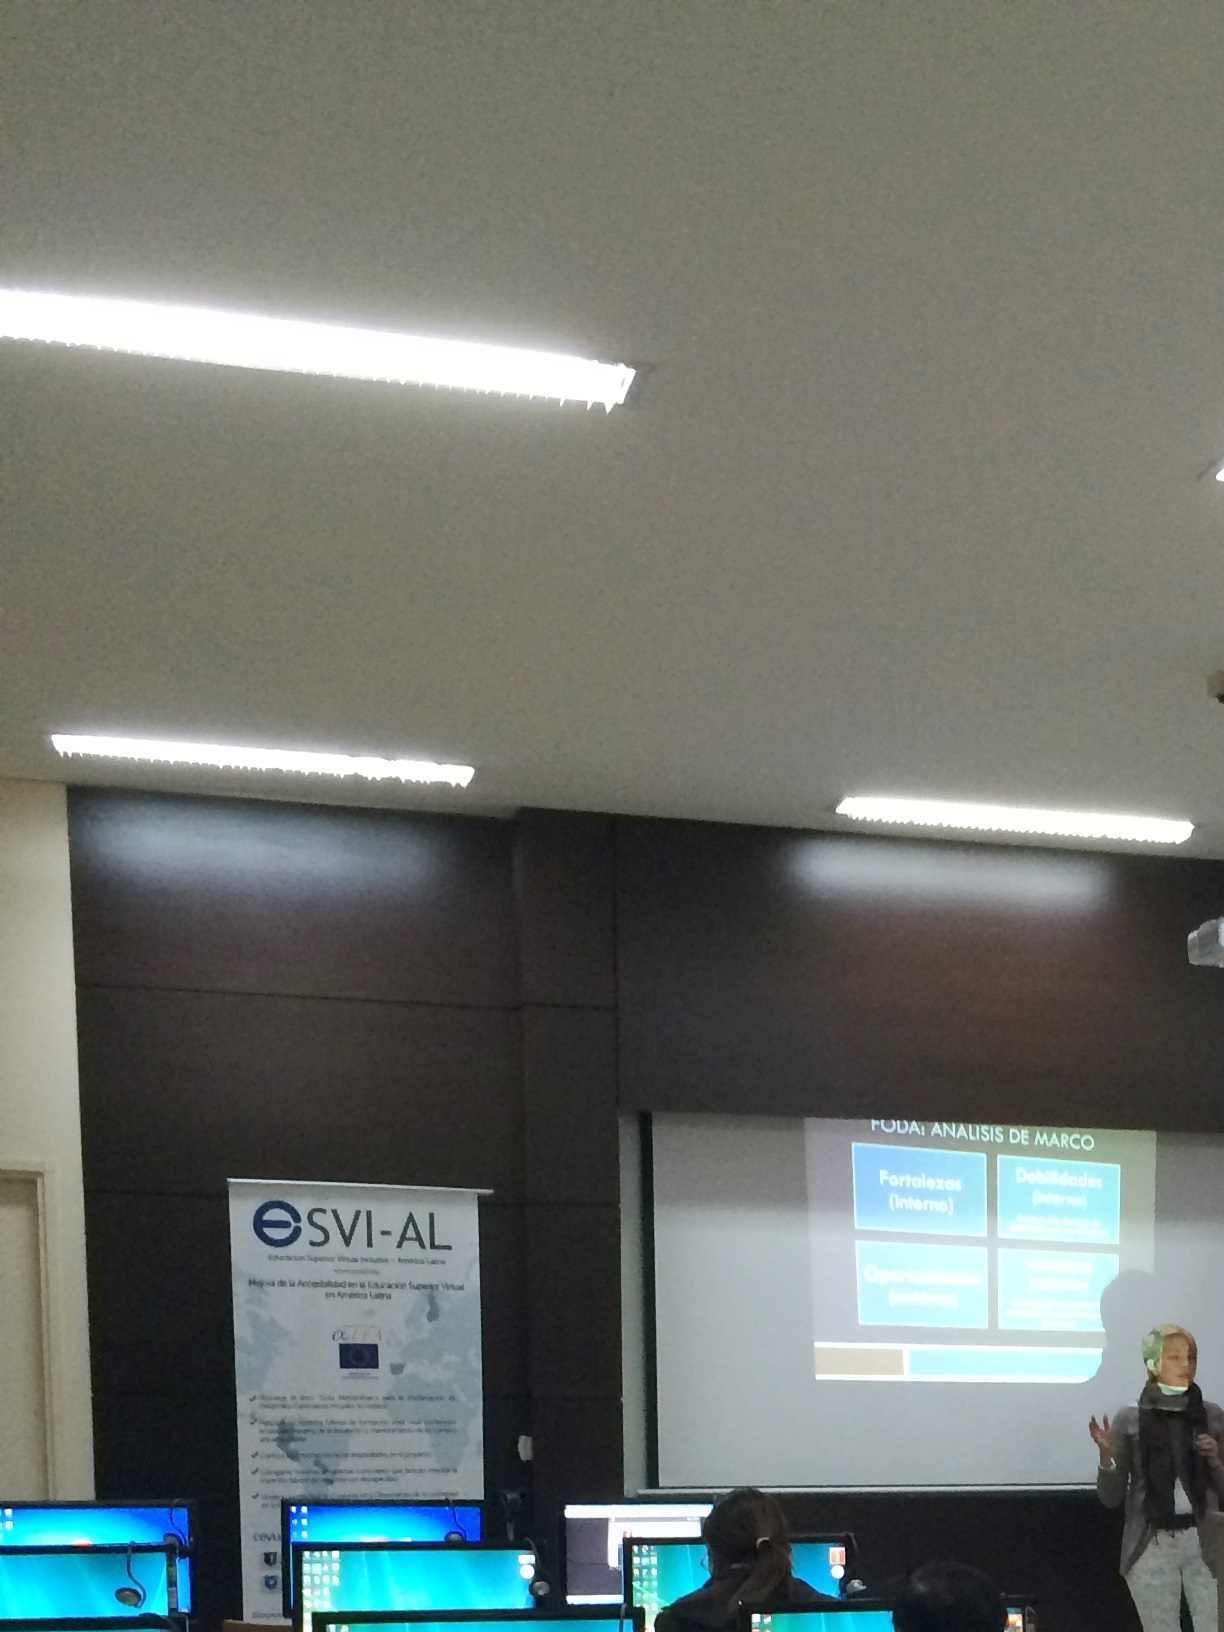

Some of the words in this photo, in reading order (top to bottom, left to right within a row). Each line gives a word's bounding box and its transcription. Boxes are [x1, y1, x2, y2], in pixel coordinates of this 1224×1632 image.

[1009, 1129, 1029, 1145] DE
[1034, 1132, 1095, 1151] MARCO
[880, 1170, 962, 1192] Fortalezas
[1015, 1167, 1103, 1189] Debilidades
[889, 1194, 954, 1215] (interno)
